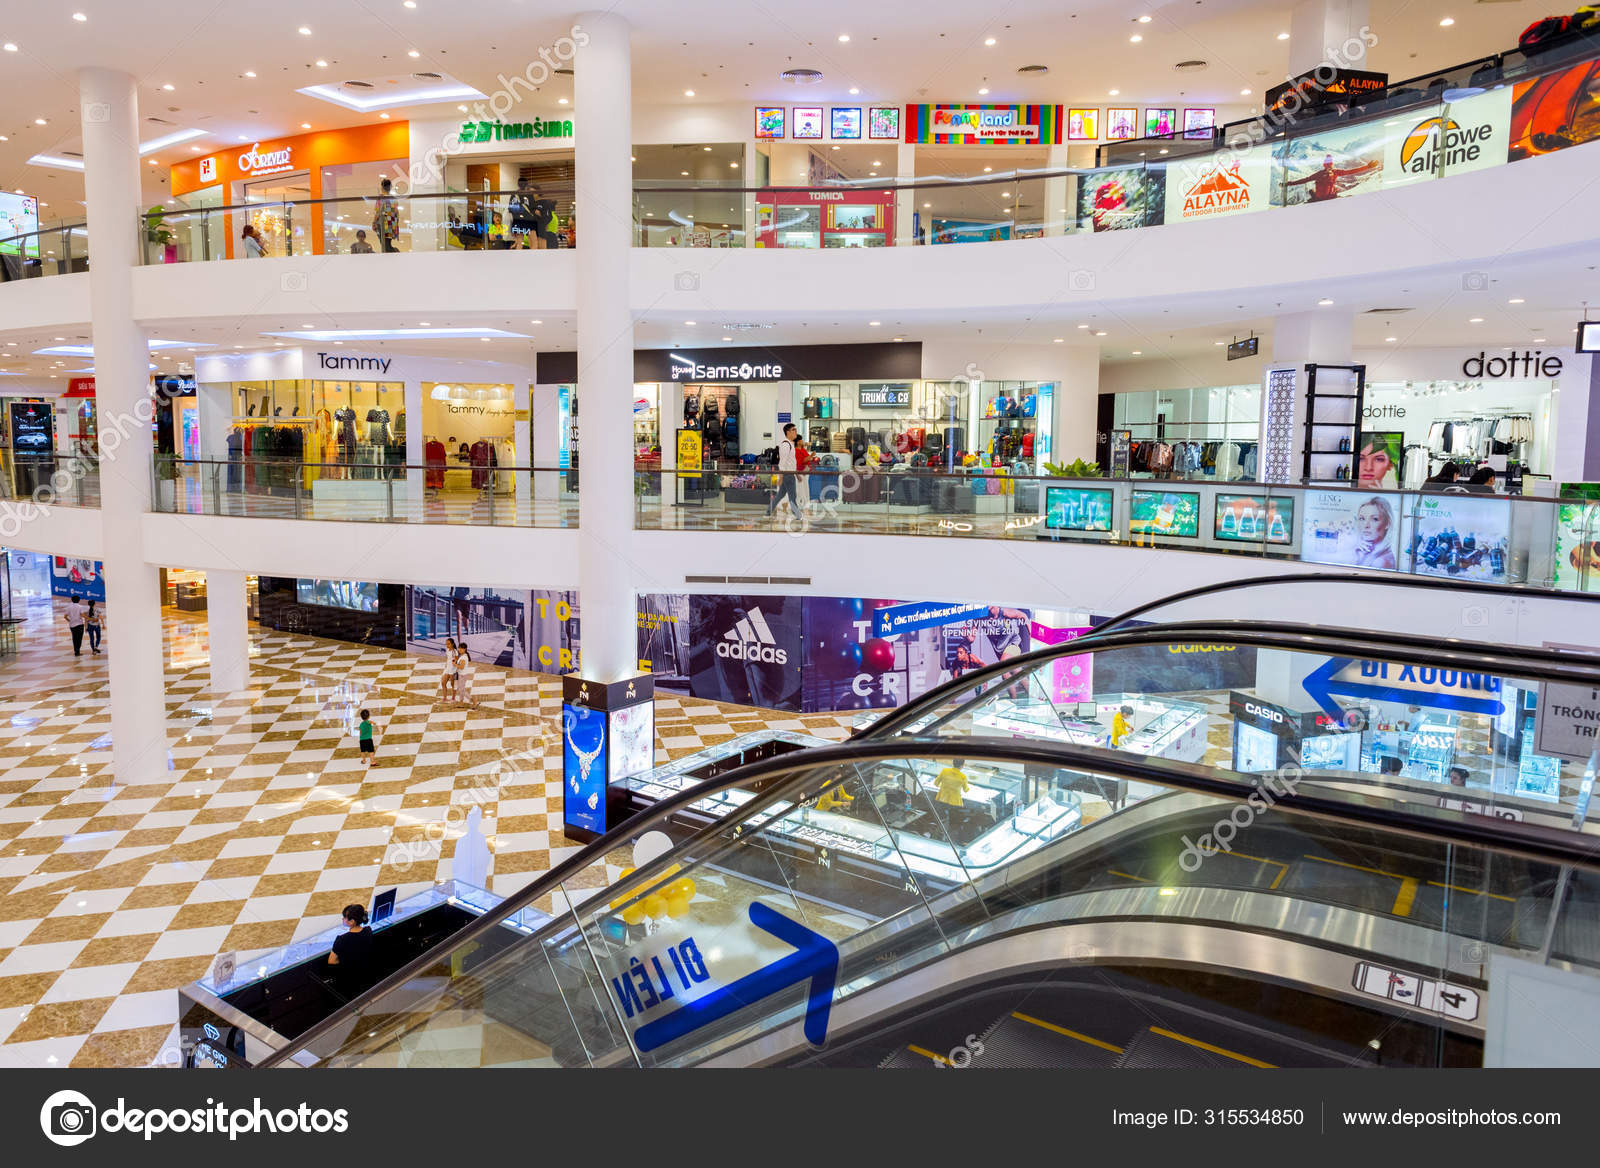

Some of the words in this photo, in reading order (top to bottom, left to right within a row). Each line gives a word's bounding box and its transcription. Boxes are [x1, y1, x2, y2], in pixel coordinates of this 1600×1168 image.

[1350, 78, 1384, 90] ALAYNA
[1433, 124, 1492, 152] Lowe
[1412, 144, 1480, 174] alpine
[808, 192, 844, 200] TOMICA
[1183, 188, 1250, 211] ALAYNA
[1183, 208, 1212, 218] OUTDOOR
[1214, 203, 1250, 214] EQUIPMENT
[317, 353, 391, 374] Tammy
[696, 363, 782, 379] Samsonite
[1463, 351, 1563, 377] dottie
[861, 392, 886, 403] TRUNK
[888, 392, 896, 403] &
[447, 404, 485, 415] Tammy
[1362, 405, 1406, 418] dottie
[536, 598, 571, 621] TO
[942, 628, 977, 637] OPENING
[973, 618, 1003, 628] VINCOM
[538, 645, 581, 669] CR
[716, 640, 788, 664] adidas
[1245, 702, 1283, 723] CASIO
[1440, 989, 1466, 1008] 4
